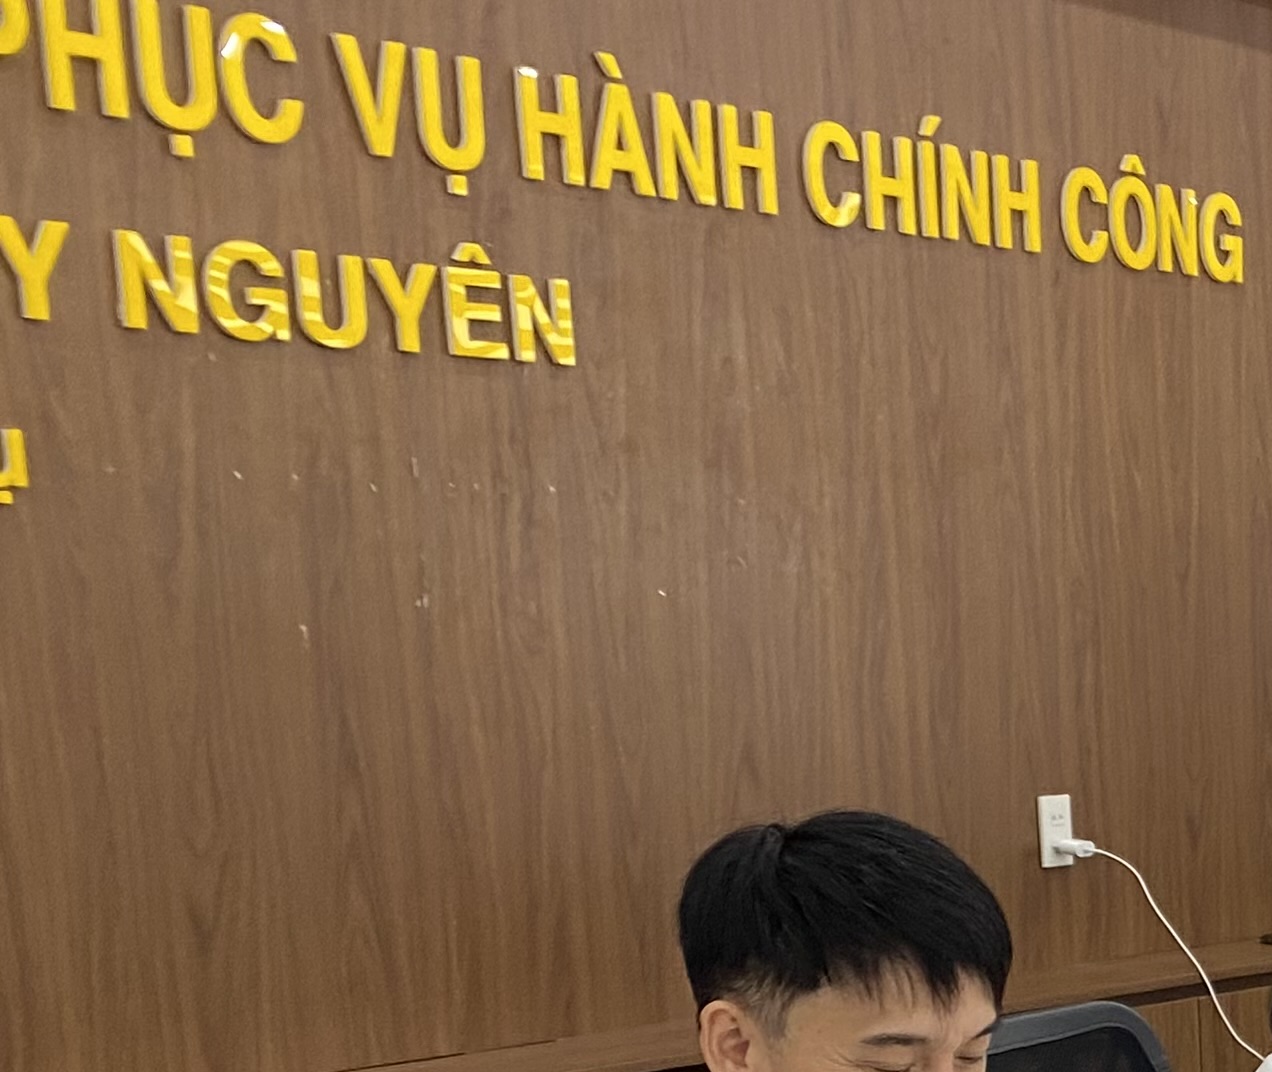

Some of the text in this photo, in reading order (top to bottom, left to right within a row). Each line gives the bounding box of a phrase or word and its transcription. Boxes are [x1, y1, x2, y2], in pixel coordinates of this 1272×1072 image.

[331, 33, 486, 196] VỤ
[514, 52, 779, 214] HÀNH
[802, 115, 1041, 253] CHÍNH
[1060, 154, 1244, 284] CÔNG
[113, 229, 577, 367] NGUYÊN
